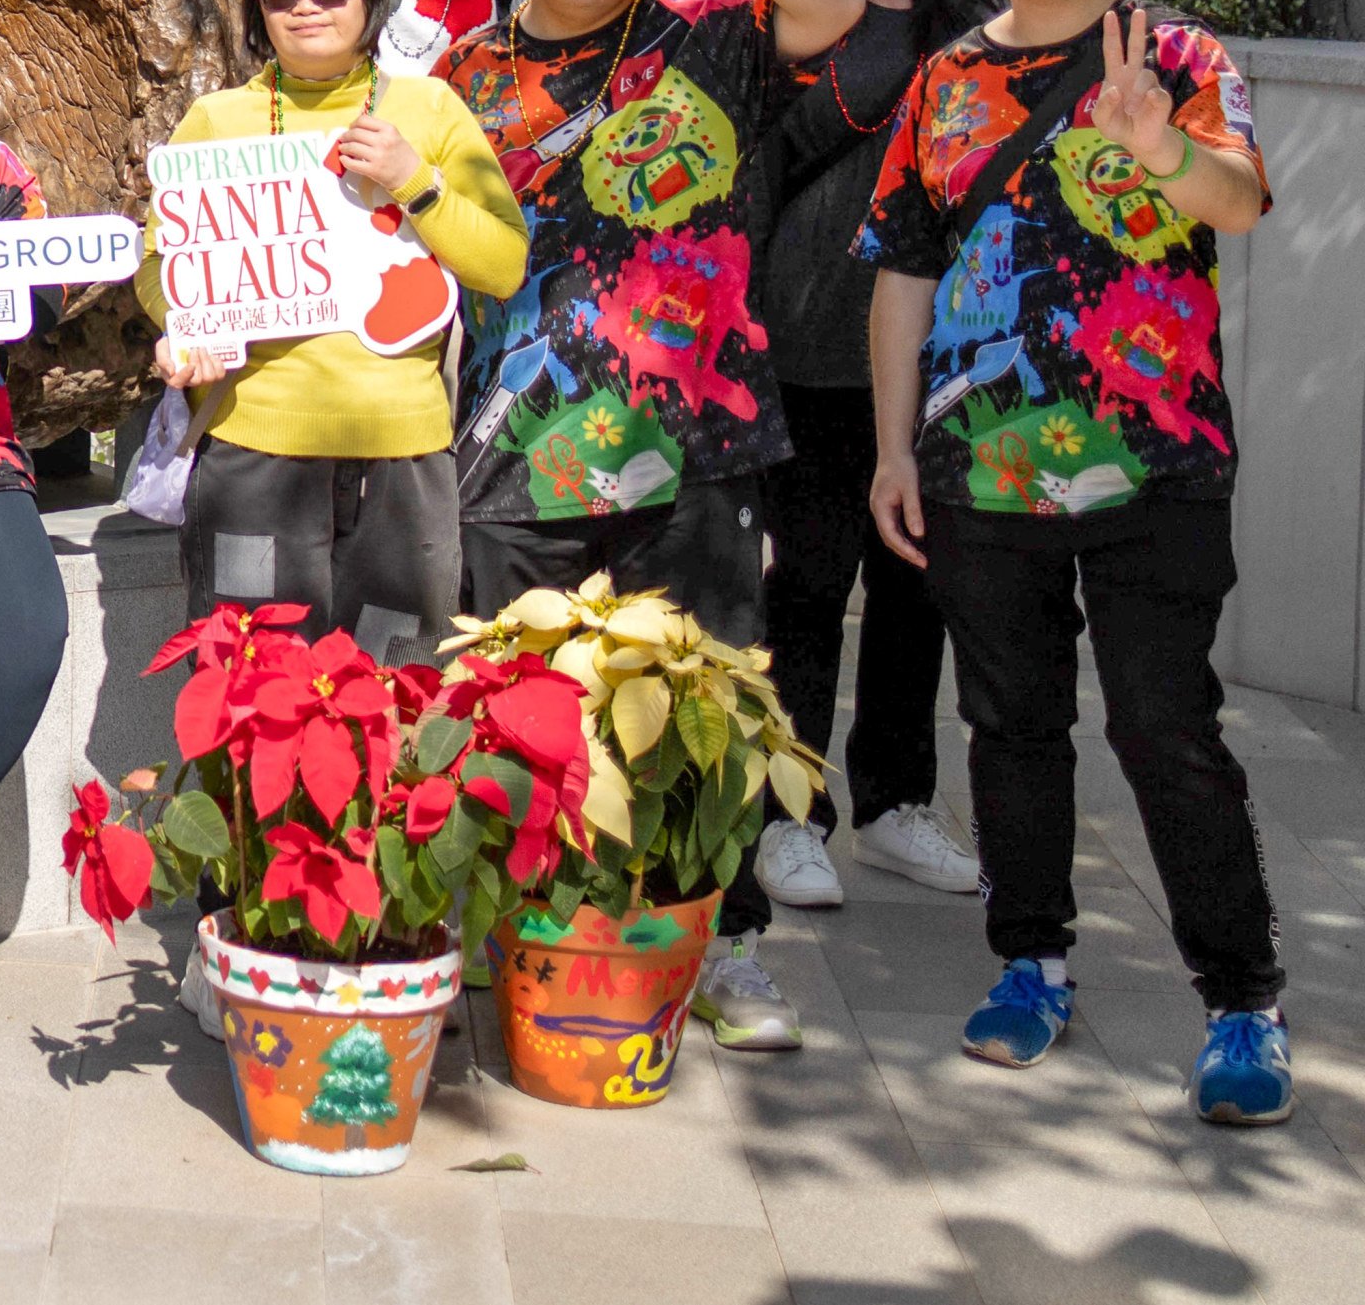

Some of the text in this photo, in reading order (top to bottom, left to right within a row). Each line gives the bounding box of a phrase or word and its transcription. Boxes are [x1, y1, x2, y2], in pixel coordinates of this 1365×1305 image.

[152, 138, 320, 185] OPERATION
[158, 177, 329, 247] SANTA
[166, 238, 332, 310] CLAUS
[172, 298, 339, 338] 愛心聖誕大行動
